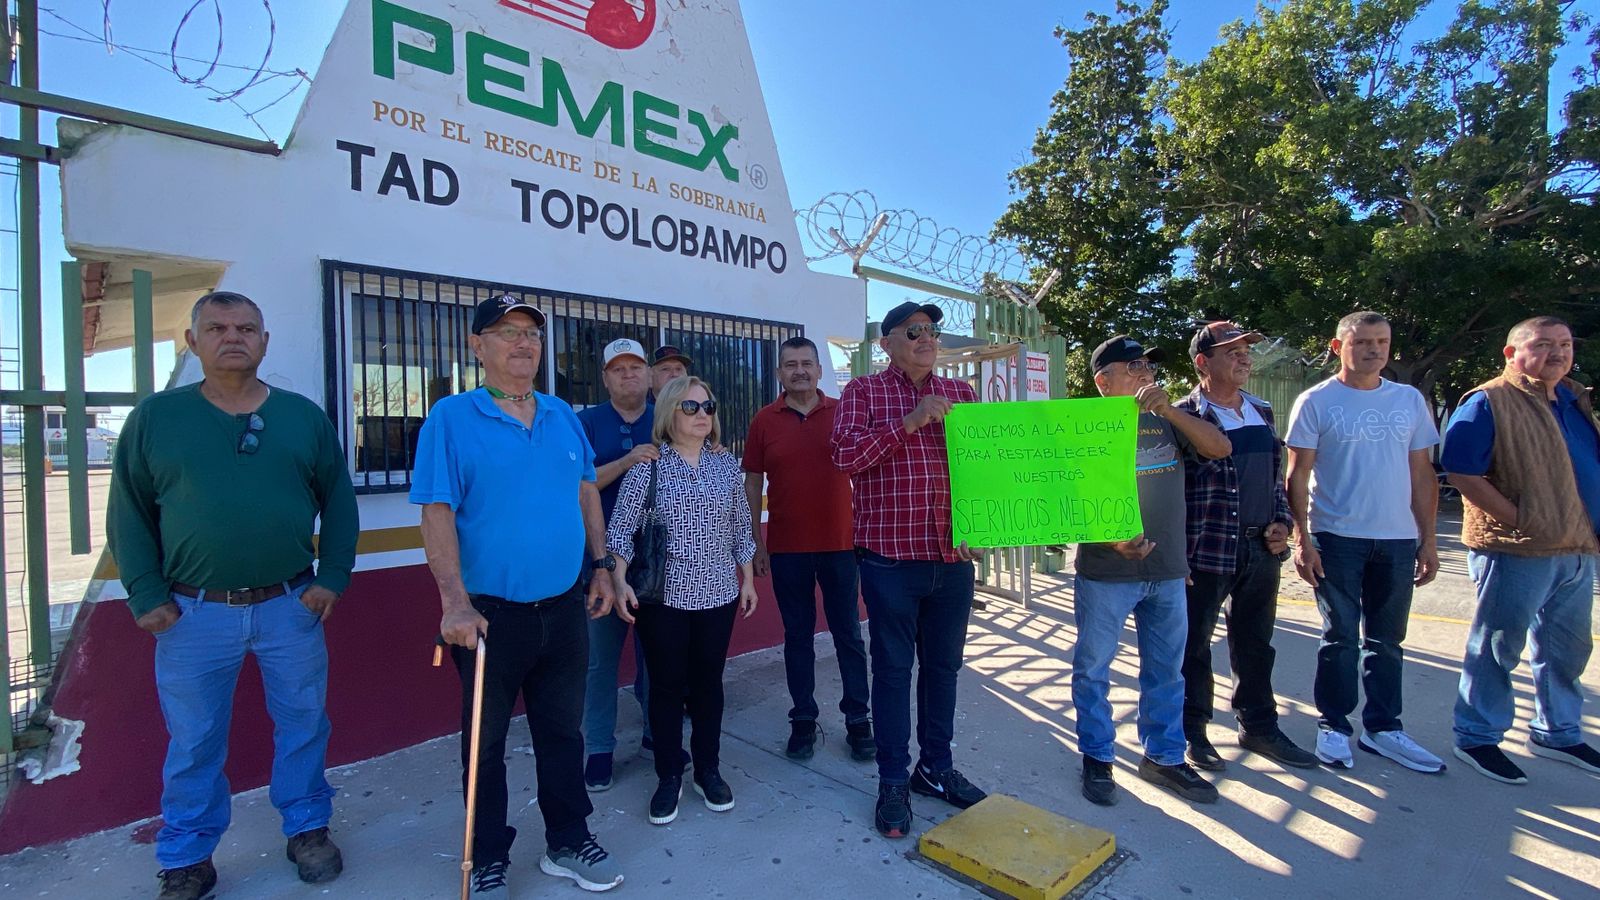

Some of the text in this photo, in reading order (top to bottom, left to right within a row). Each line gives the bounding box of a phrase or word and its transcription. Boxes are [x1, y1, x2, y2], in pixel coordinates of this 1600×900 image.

[372, 0, 740, 183] PEMEX
[372, 100, 767, 224] POR EL RESCATE DE LA SOBERANÍA
[336, 139, 787, 274] TAD TOPOLOBAMPO
[957, 423, 1025, 439] VOLVEMOS
[1032, 424, 1040, 436] A
[1047, 423, 1065, 436] LA
[1328, 405, 1411, 443] Lee
[956, 447, 991, 465] PARA
[1013, 468, 1086, 484] NUESTROS
[955, 495, 1136, 535] SERVICIOS MEDICOS
[1050, 532, 1071, 545] 95
